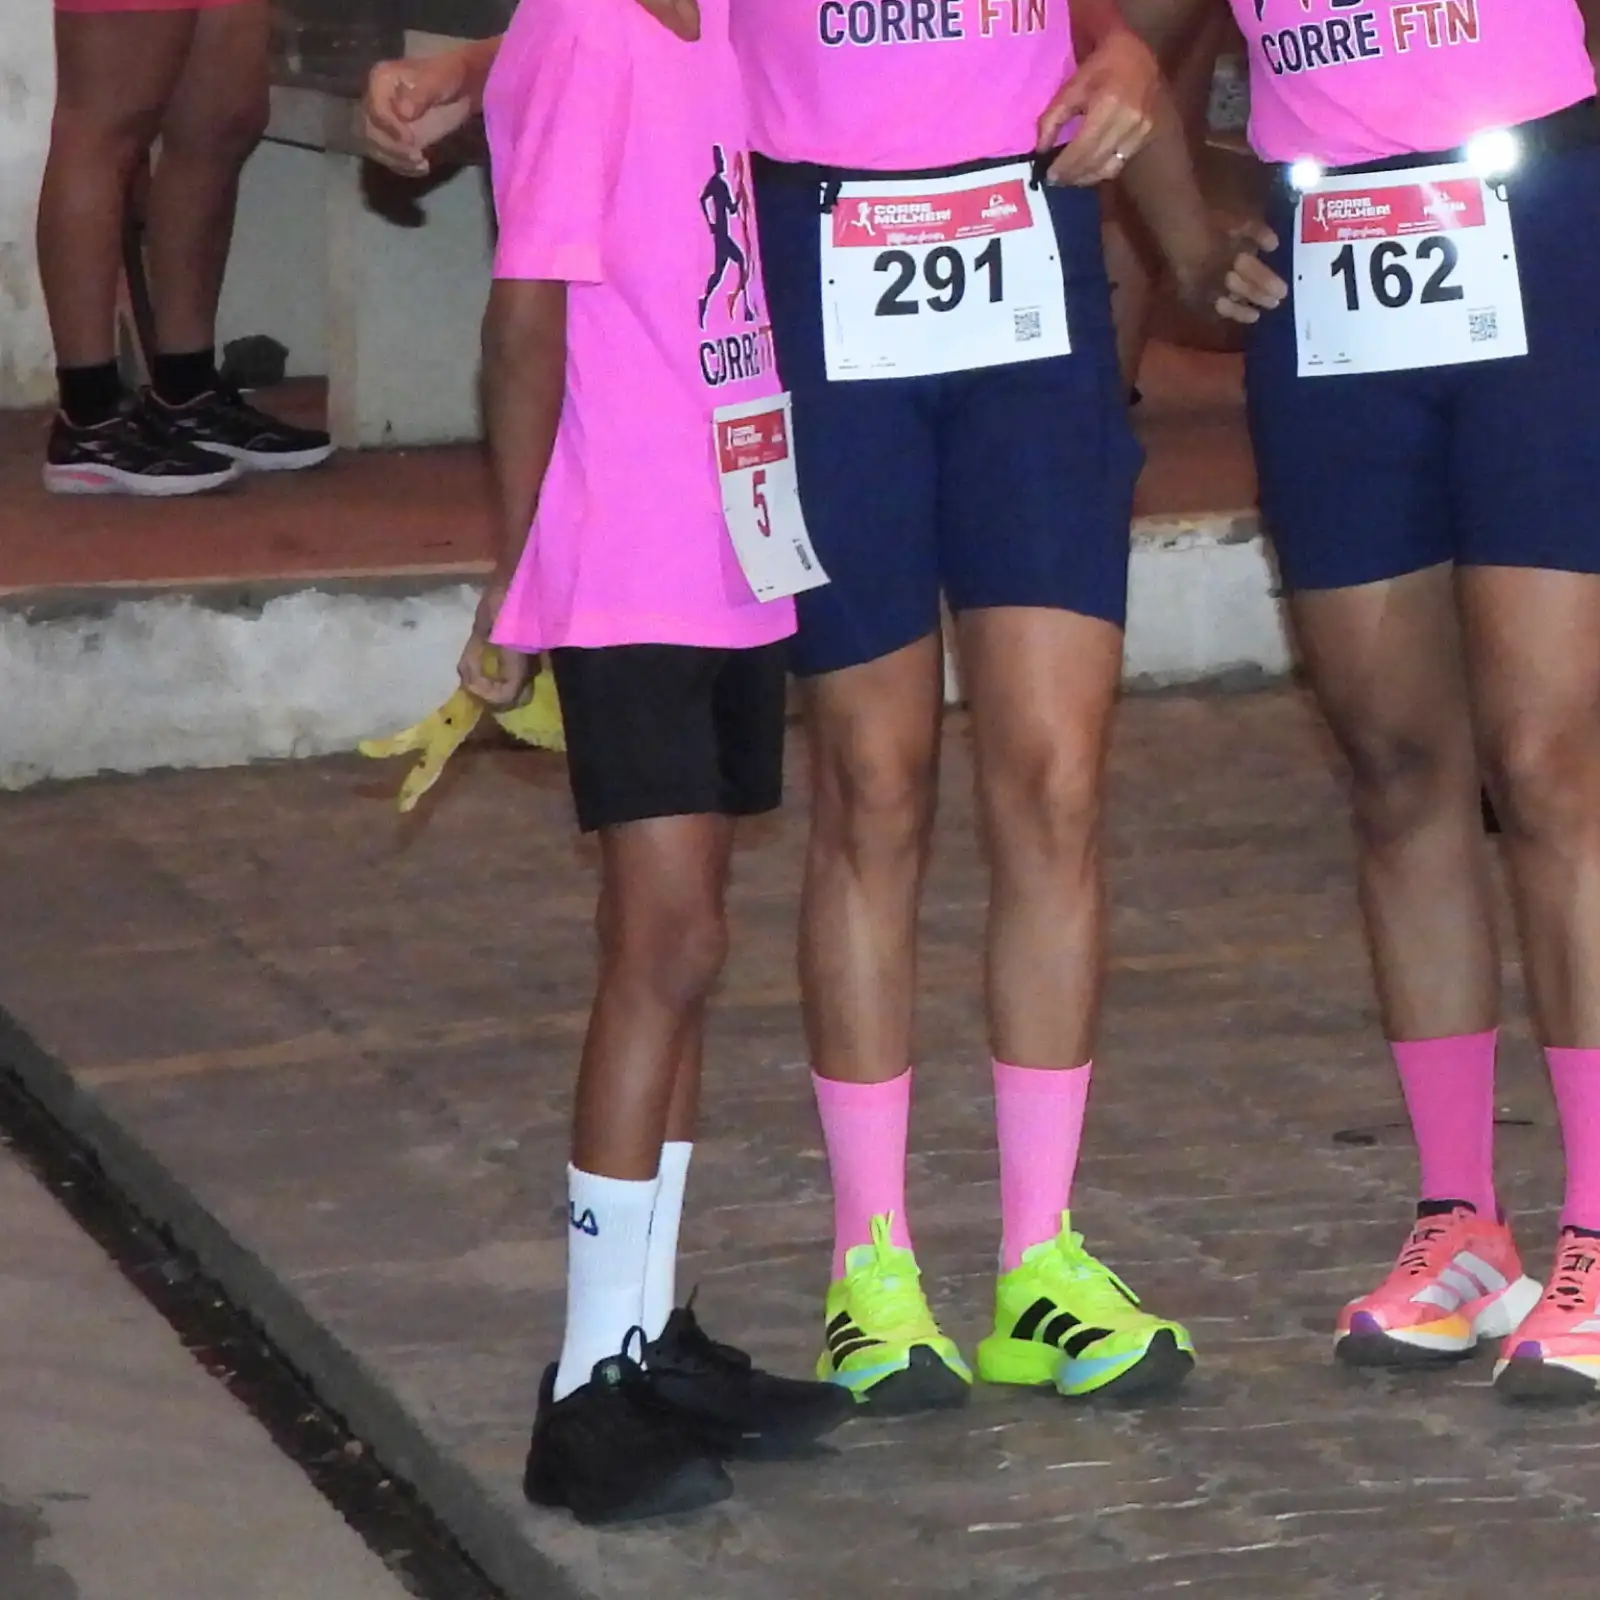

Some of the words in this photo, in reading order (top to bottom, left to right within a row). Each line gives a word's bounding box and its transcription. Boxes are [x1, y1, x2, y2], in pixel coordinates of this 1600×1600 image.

[1260, 12, 1381, 76] CORRE
[872, 236, 1004, 317] 291
[1329, 234, 1465, 312] 162
[752, 468, 771, 538] 5
